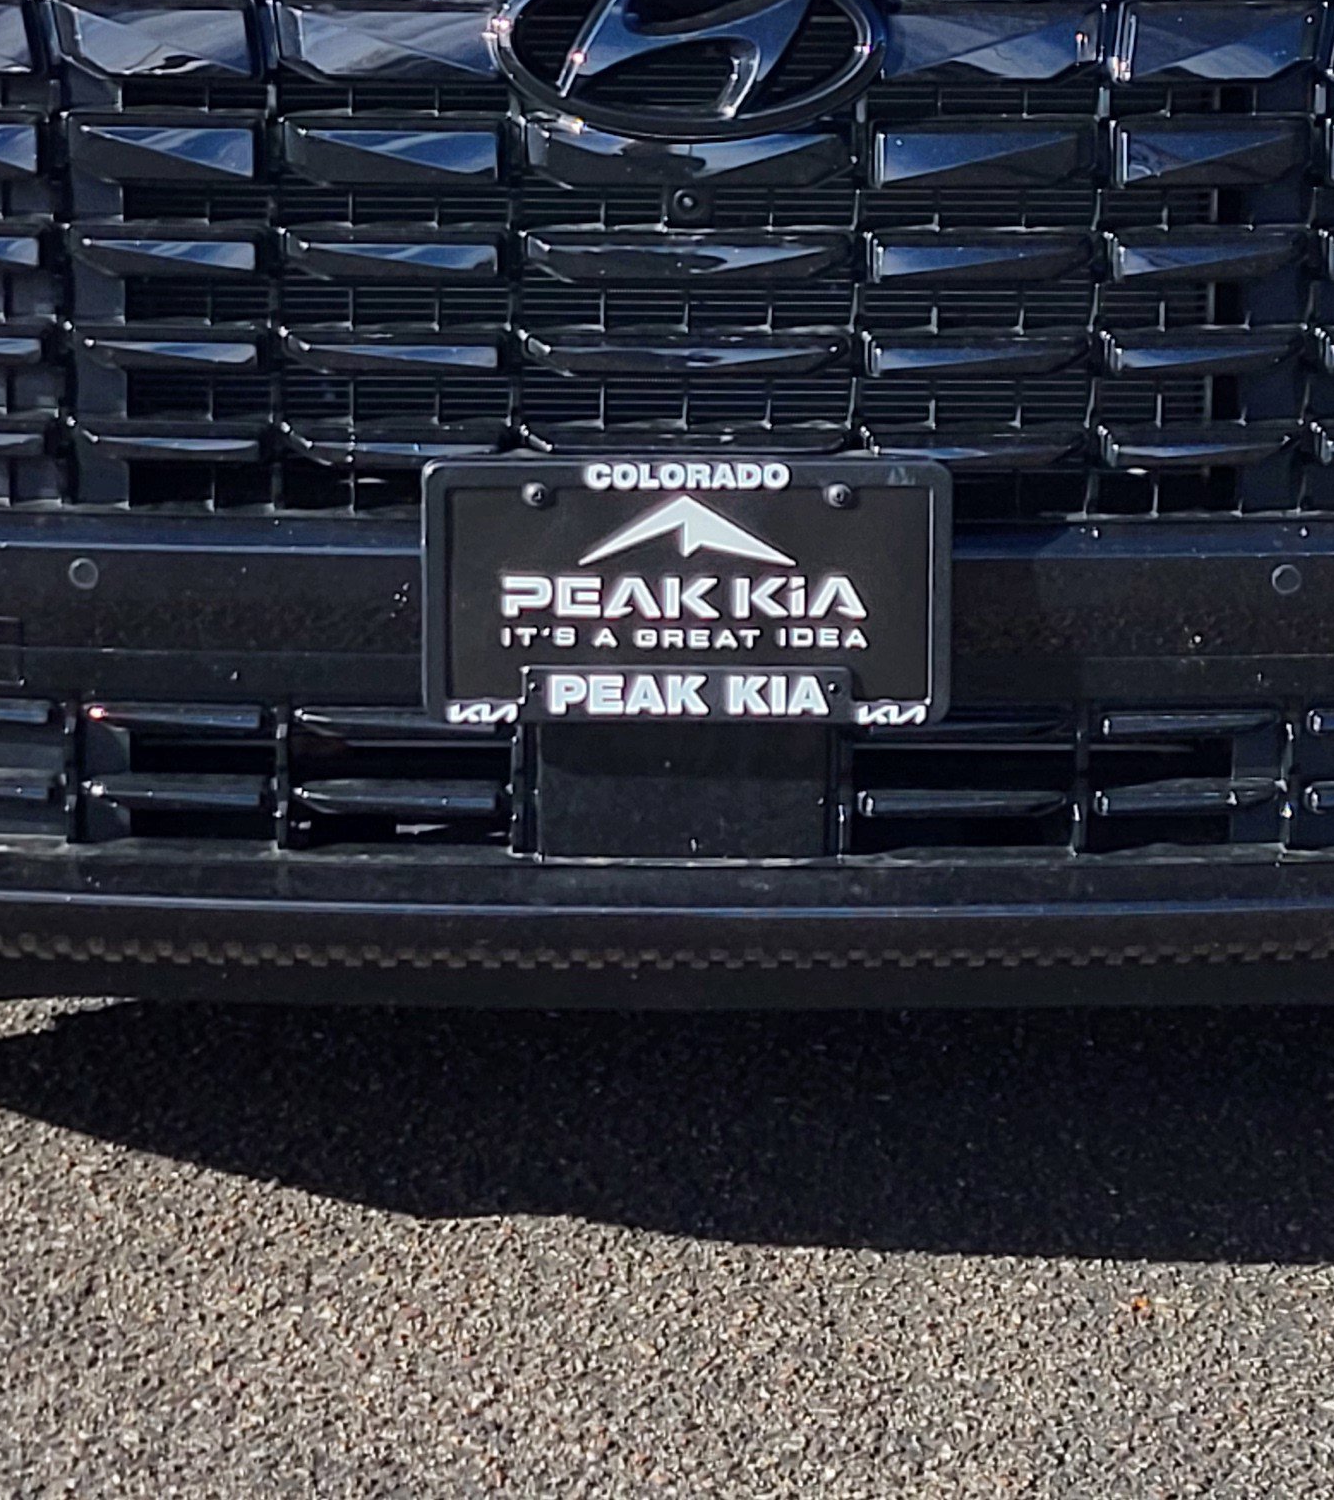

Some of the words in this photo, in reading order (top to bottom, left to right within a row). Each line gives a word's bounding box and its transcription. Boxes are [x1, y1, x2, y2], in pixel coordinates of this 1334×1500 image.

[584, 463, 790, 489] COLORADO
[501, 576, 721, 619] PEAK
[501, 626, 577, 648] IT'S
[594, 627, 618, 648] A
[634, 628, 761, 649] GREAT
[779, 627, 868, 649] IDEA
[550, 675, 709, 716] PEAK
[726, 675, 829, 716] KIA
